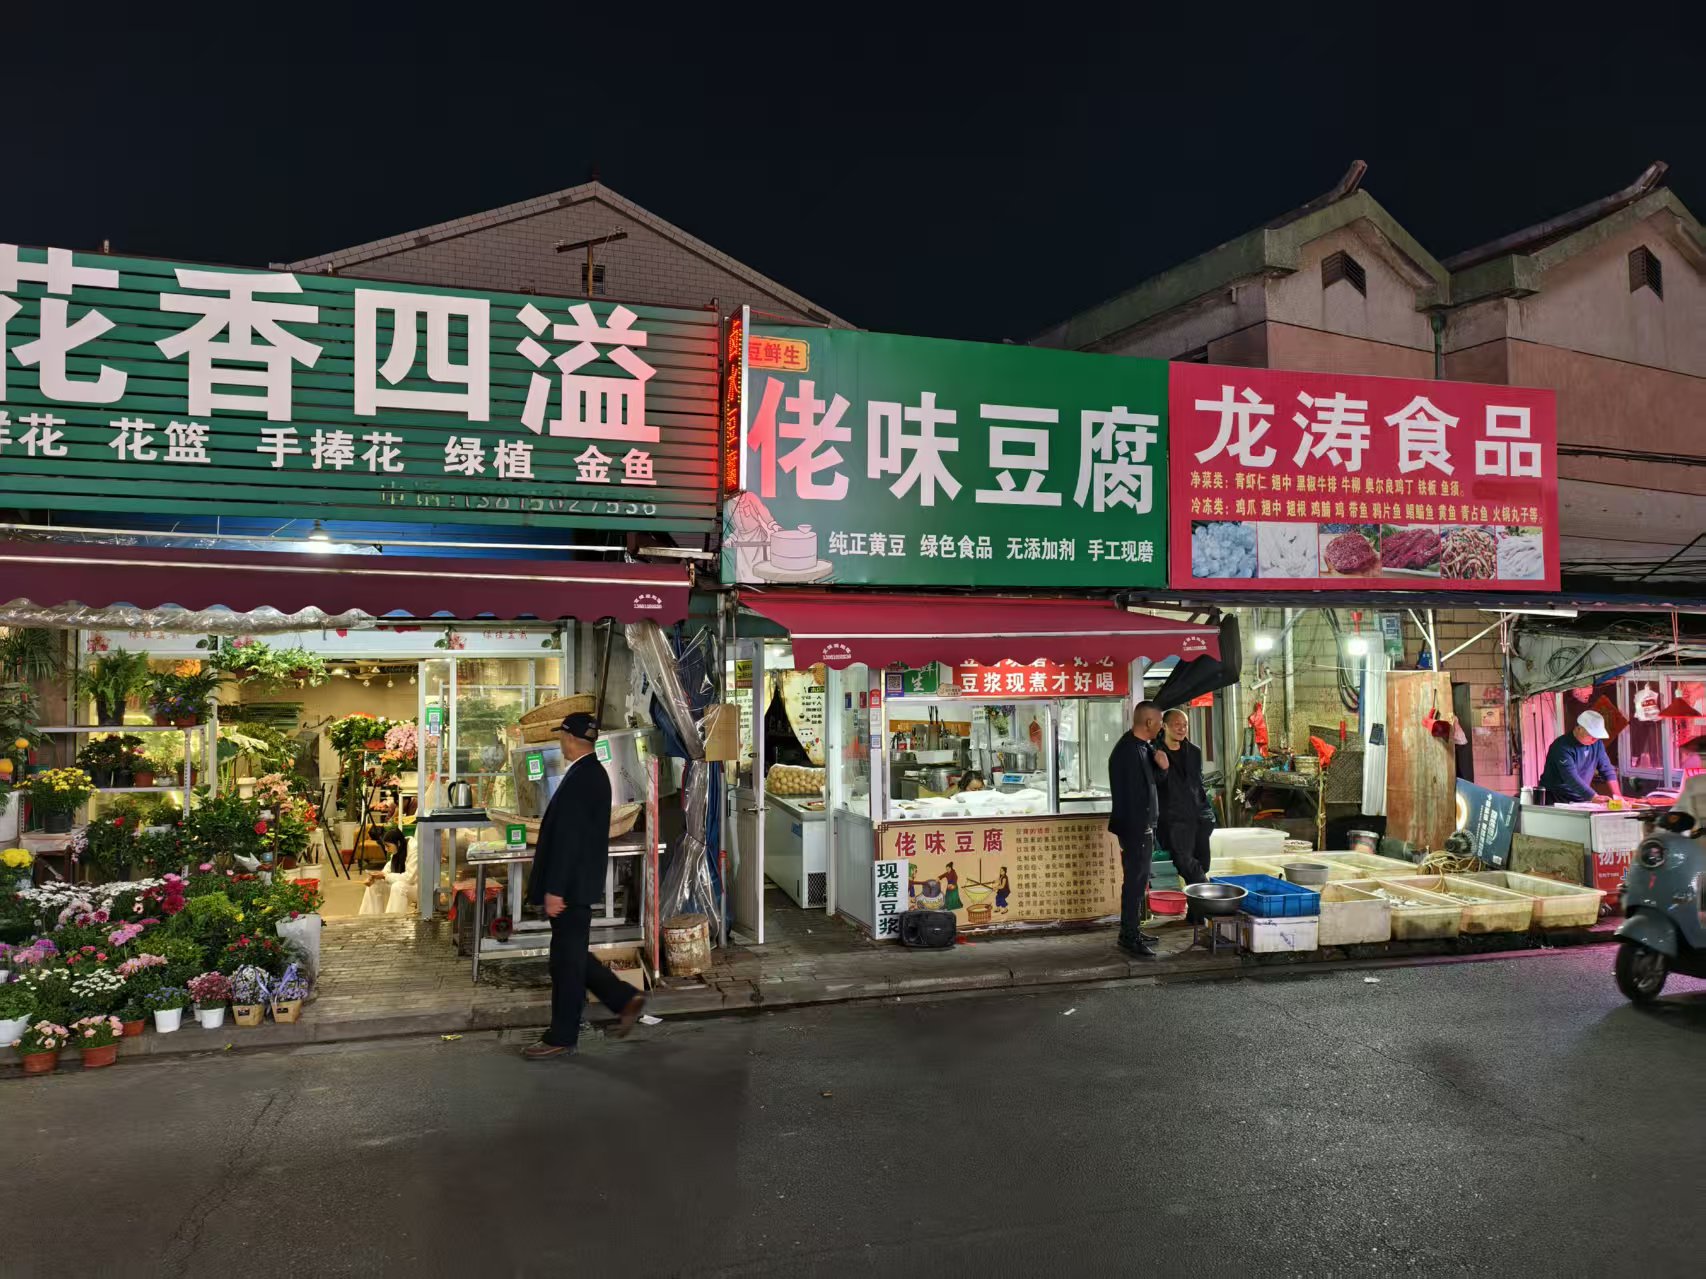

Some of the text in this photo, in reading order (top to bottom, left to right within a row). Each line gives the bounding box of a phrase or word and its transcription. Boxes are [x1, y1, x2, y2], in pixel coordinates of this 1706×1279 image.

[0, 243, 660, 443] 花香四溢
[109, 417, 211, 463] 花篮
[257, 427, 405, 472] 手捧花
[444, 436, 535, 478] 绿植
[573, 445, 657, 485] 金鱼
[747, 377, 1159, 515] 佬味豆腐
[1194, 385, 1542, 478] 龙涛食品
[1235, 473, 1267, 490] 青虾仁
[1272, 474, 1292, 492] 翅中
[1296, 475, 1338, 493] 黑椒牛排
[1365, 477, 1414, 495] 奥尔良鸡丁
[1235, 498, 1257, 516] 鸡爪
[1261, 499, 1282, 517] 翅中
[1349, 502, 1369, 519] 带鱼
[1438, 505, 1457, 521] 黄鱼
[828, 531, 1154, 563] 纯正黄豆 绿色食品 无添加剂 手工现磨
[960, 672, 1115, 693] 豆浆现煮才好喝
[895, 828, 1004, 857] 佬味豆腐
[877, 862, 899, 935] 现磨豆浆
